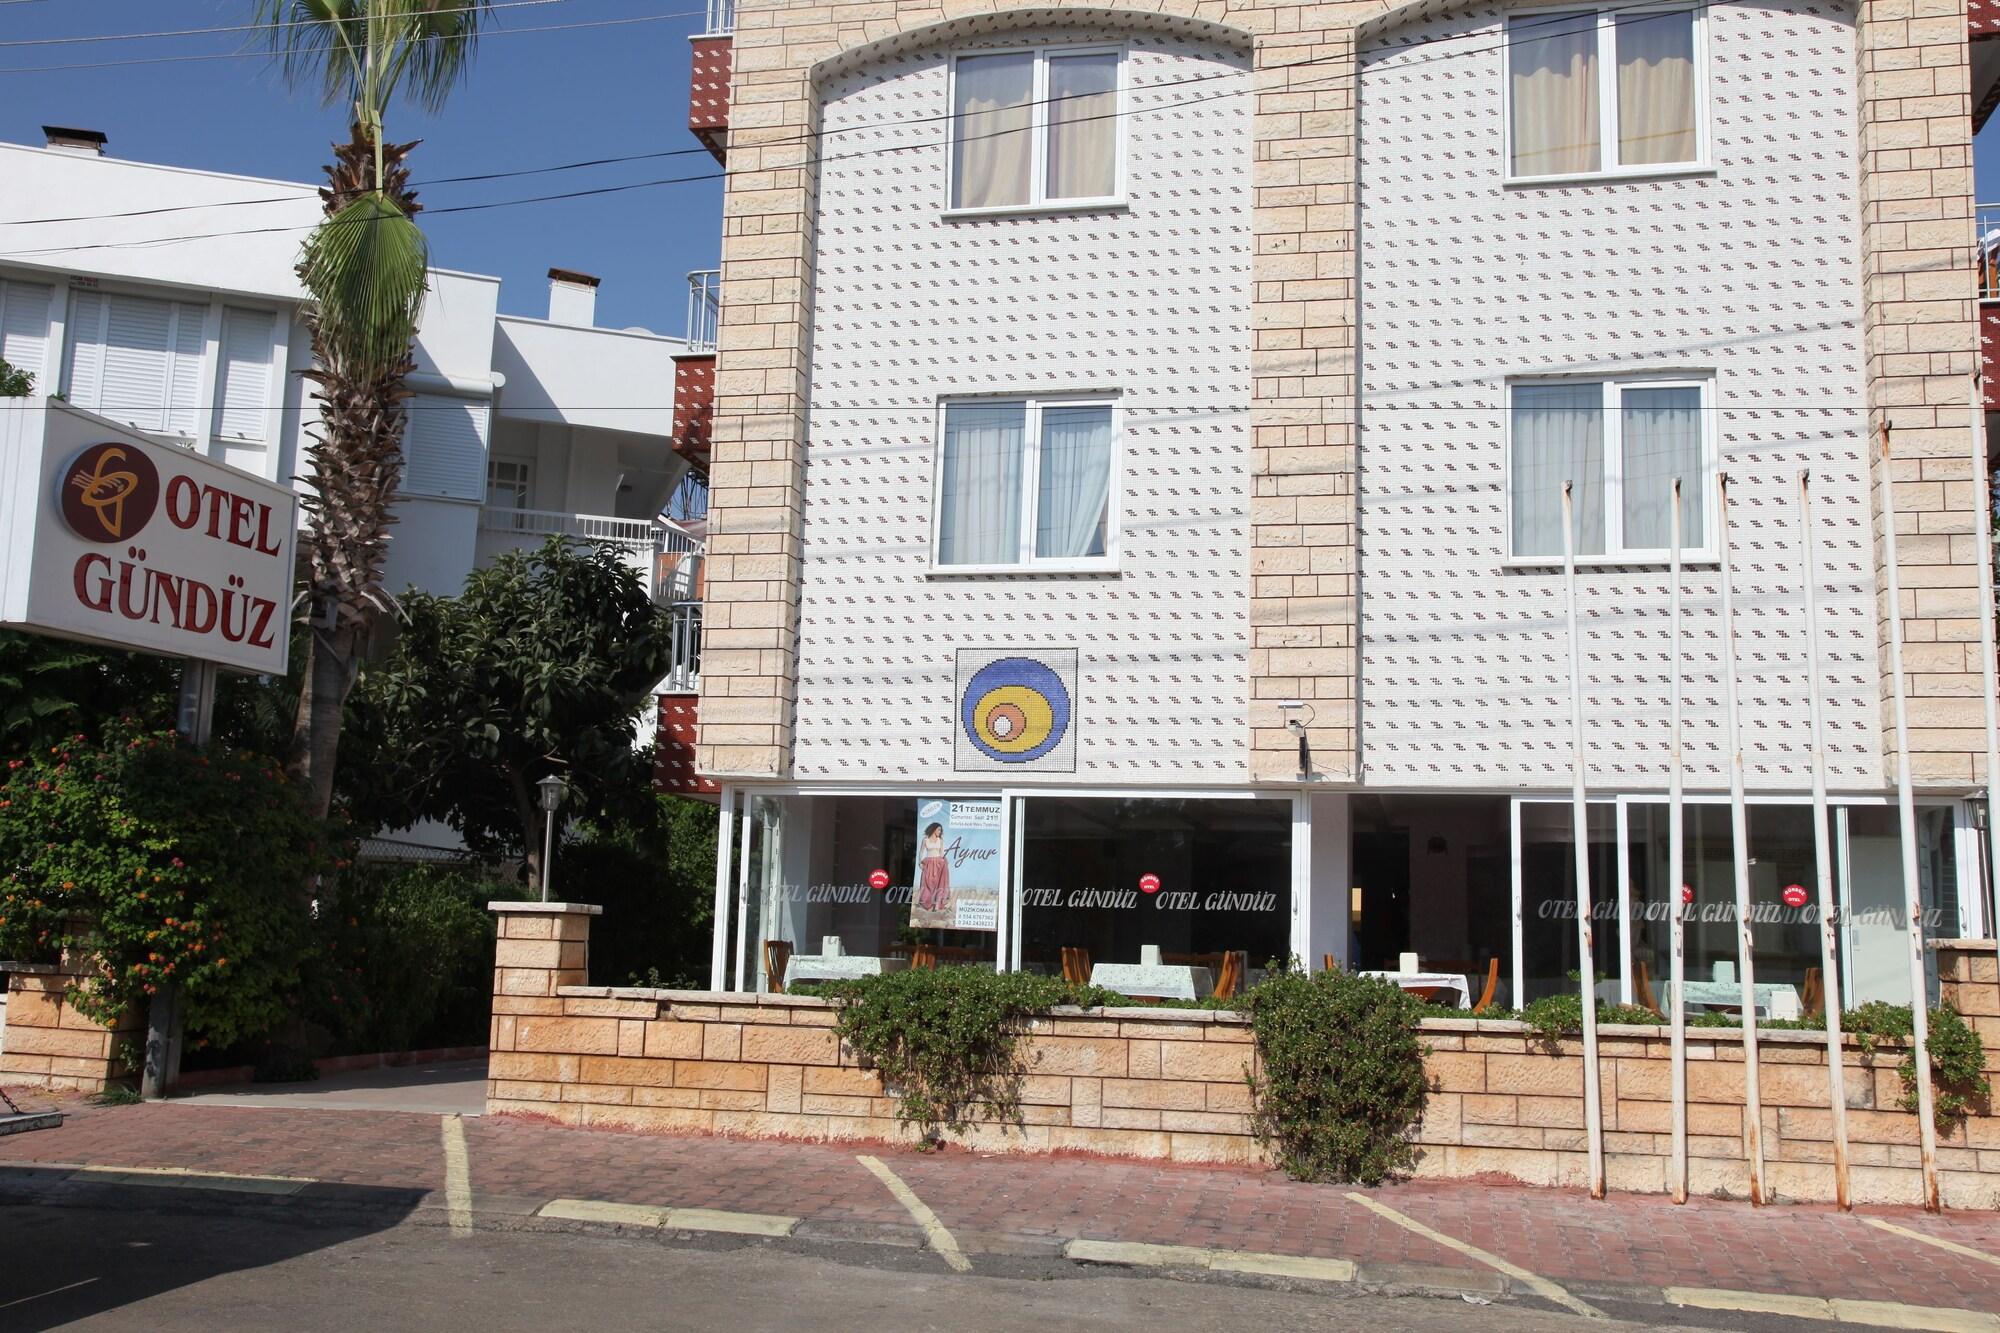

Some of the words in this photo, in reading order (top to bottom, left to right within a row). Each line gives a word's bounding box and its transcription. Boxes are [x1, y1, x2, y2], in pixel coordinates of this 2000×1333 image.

[166, 475, 282, 557] OTEL
[73, 546, 277, 649] GÜNDÜZ
[952, 804, 964, 813] 21
[966, 806, 1000, 814] TEMMUZ
[943, 836, 997, 868] Aynur
[807, 883, 872, 904] GÜNDÜZ
[1022, 888, 1064, 906] OTEL
[1068, 887, 1139, 909] GÜNDÜZ
[1155, 891, 1201, 910] OTEL
[1205, 890, 1276, 912] GÜNDÜZ
[1538, 899, 1579, 919] OTE
[1647, 902, 1697, 922] OTL
[1859, 904, 1943, 927] GÜNÜZ
